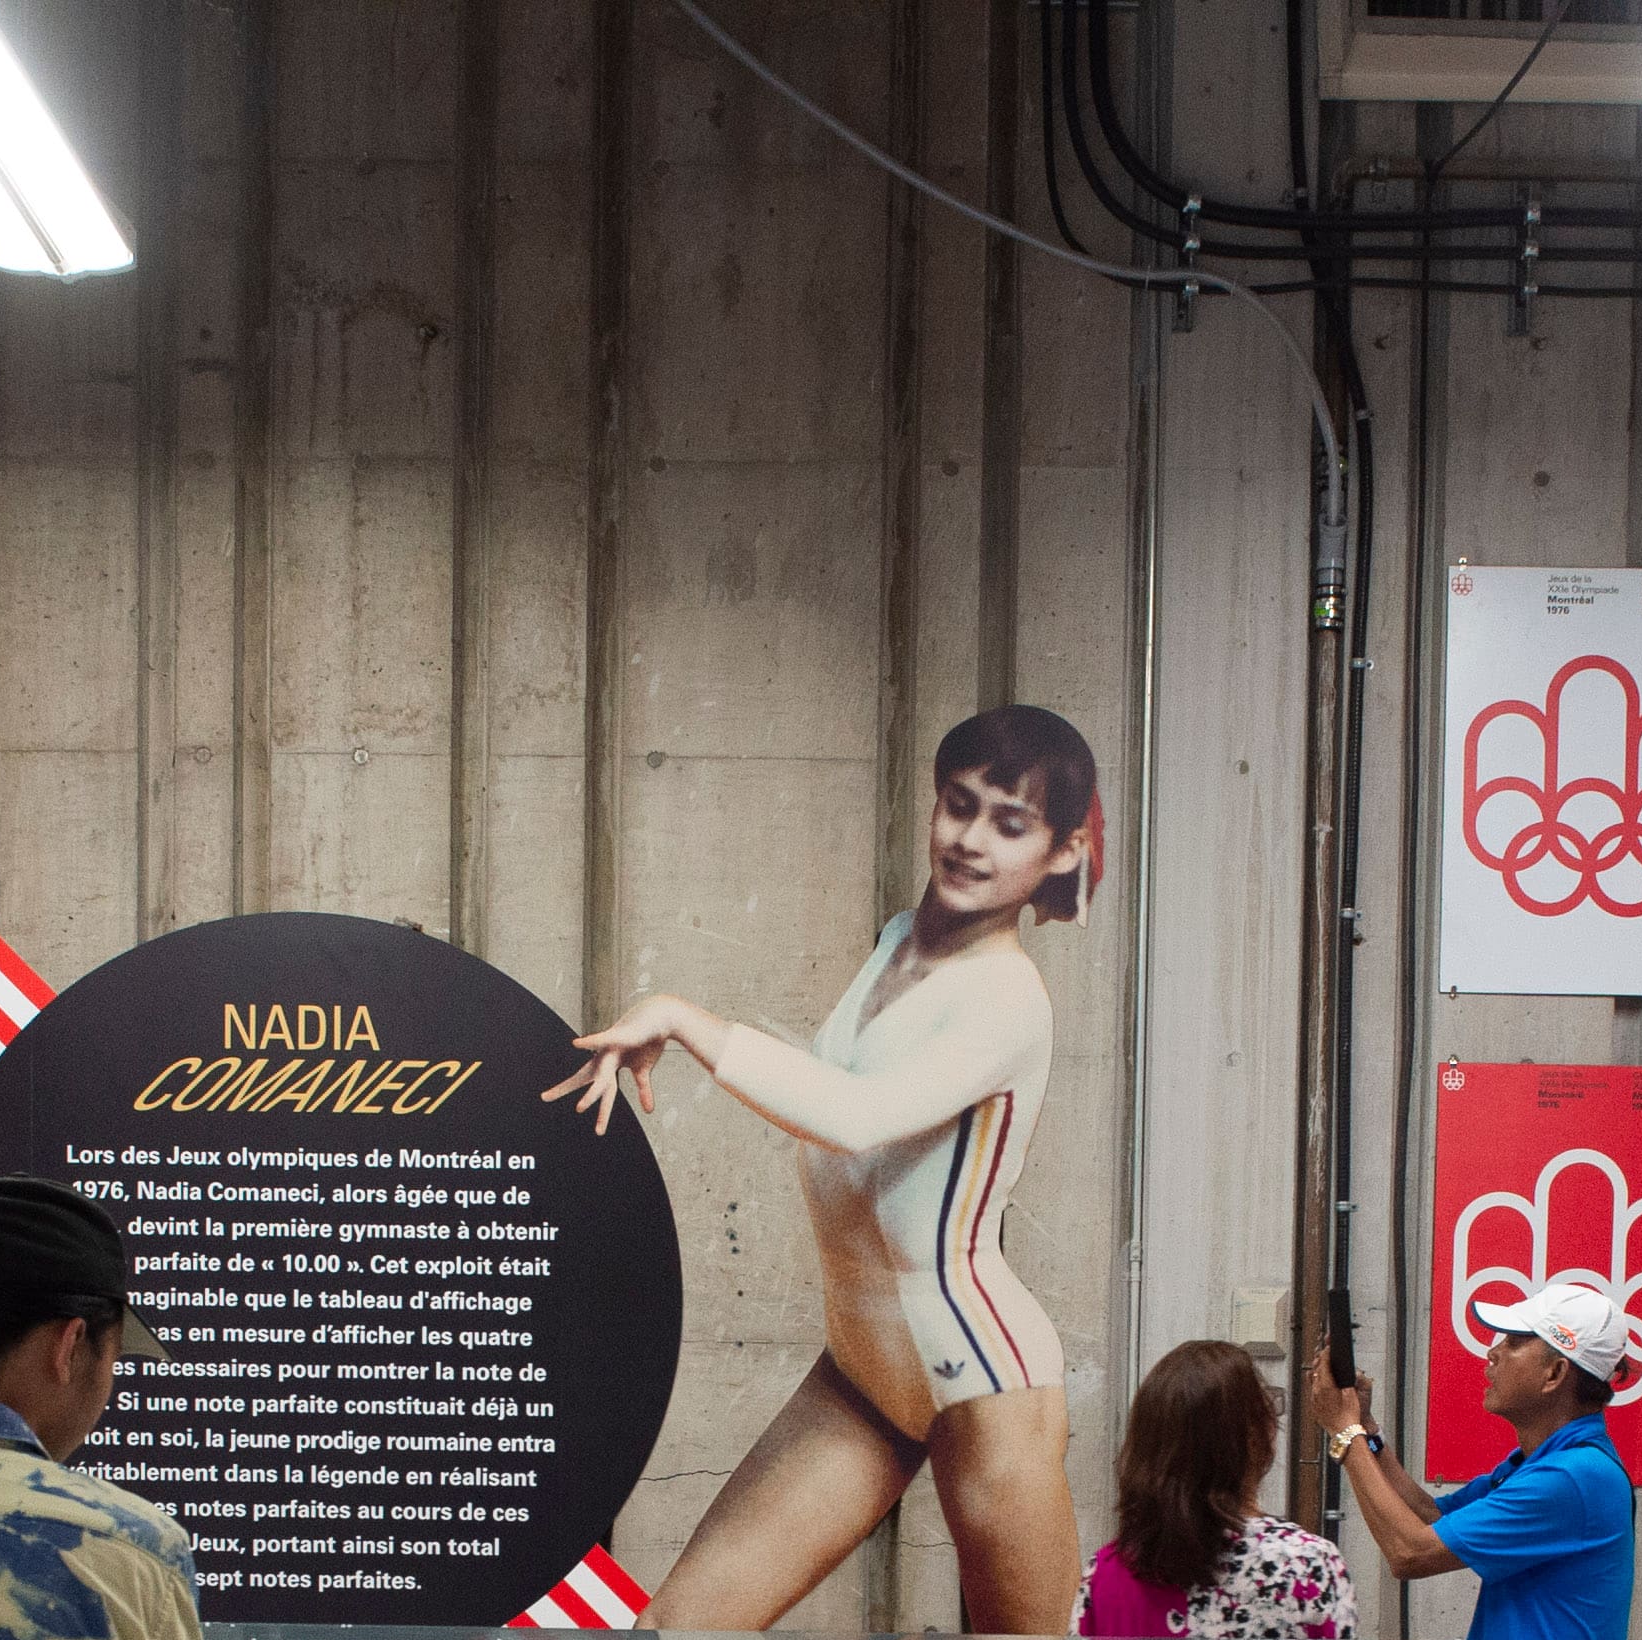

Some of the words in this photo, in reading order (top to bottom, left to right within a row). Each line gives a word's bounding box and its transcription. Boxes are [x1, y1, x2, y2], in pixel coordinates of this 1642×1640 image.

[1546, 606, 1570, 615] 1976
[1547, 595, 1594, 605] Montréal
[224, 1004, 380, 1051] NADIA
[133, 1057, 483, 1115] COMANECI
[66, 1144, 116, 1165] Lors
[120, 1145, 161, 1165] des
[166, 1145, 221, 1166] Jeux
[226, 1146, 359, 1171] olympiques
[364, 1148, 393, 1168] de
[399, 1148, 502, 1170] Montréal
[507, 1154, 536, 1170] en
[72, 1180, 130, 1202] 1976,
[137, 1180, 202, 1201] Nadia
[207, 1181, 326, 1205] Comaneci,
[332, 1183, 388, 1204] alors
[393, 1183, 449, 1208] âgée
[454, 1189, 497, 1209] que
[502, 1185, 531, 1206] de
[127, 1215, 200, 1236] devint
[205, 1216, 225, 1237] la
[231, 1217, 333, 1241] première
[338, 1221, 451, 1243] gymnaste
[456, 1220, 470, 1240] à
[476, 1220, 559, 1241] obtenir
[134, 1251, 222, 1275] parfaite
[227, 1252, 256, 1273] de
[282, 1253, 341, 1273] 10.00
[370, 1254, 409, 1275] Cet
[414, 1255, 493, 1279] exploit
[498, 1256, 551, 1277] était
[244, 1292, 287, 1312] que
[293, 1288, 313, 1309] le
[318, 1289, 403, 1310] tableau
[188, 1327, 216, 1342] en
[222, 1327, 306, 1344] mesure
[421, 1325, 453, 1346] les
[458, 1329, 533, 1350] quatre
[142, 1358, 272, 1378] nécessaires
[278, 1363, 331, 1383] pour
[337, 1362, 430, 1380] montrer
[435, 1361, 455, 1381] la
[461, 1364, 513, 1382] note
[518, 1362, 547, 1382] de
[117, 1391, 140, 1411] Si
[146, 1397, 188, 1412] une
[194, 1395, 246, 1413] note
[252, 1393, 339, 1417] parfaite
[344, 1395, 466, 1416] constituait
[471, 1397, 519, 1421] déjà
[525, 1402, 554, 1417] un
[126, 1431, 154, 1446] en
[160, 1427, 200, 1449] soi,
[205, 1427, 225, 1448] la
[228, 1428, 291, 1453] jeune
[296, 1430, 382, 1455] prodige
[386, 1431, 493, 1452] roumaine
[497, 1435, 556, 1453] entra
[224, 1463, 278, 1483] dans
[284, 1464, 304, 1484] la
[310, 1464, 400, 1489] légende
[405, 1470, 433, 1486] en
[440, 1466, 538, 1487] réalisant
[184, 1500, 247, 1518] notes
[253, 1499, 352, 1522] parfaites
[357, 1505, 384, 1520] au
[390, 1505, 453, 1521] cours
[458, 1502, 487, 1522] de
[492, 1507, 530, 1522] ces
[189, 1532, 246, 1556] Jeux,
[252, 1536, 337, 1557] portant
[342, 1535, 394, 1555] ainsi
[400, 1540, 441, 1556] son
[447, 1537, 500, 1557] total
[195, 1570, 243, 1591] sept
[249, 1570, 312, 1588] notes
[318, 1569, 422, 1593] parfaites.
